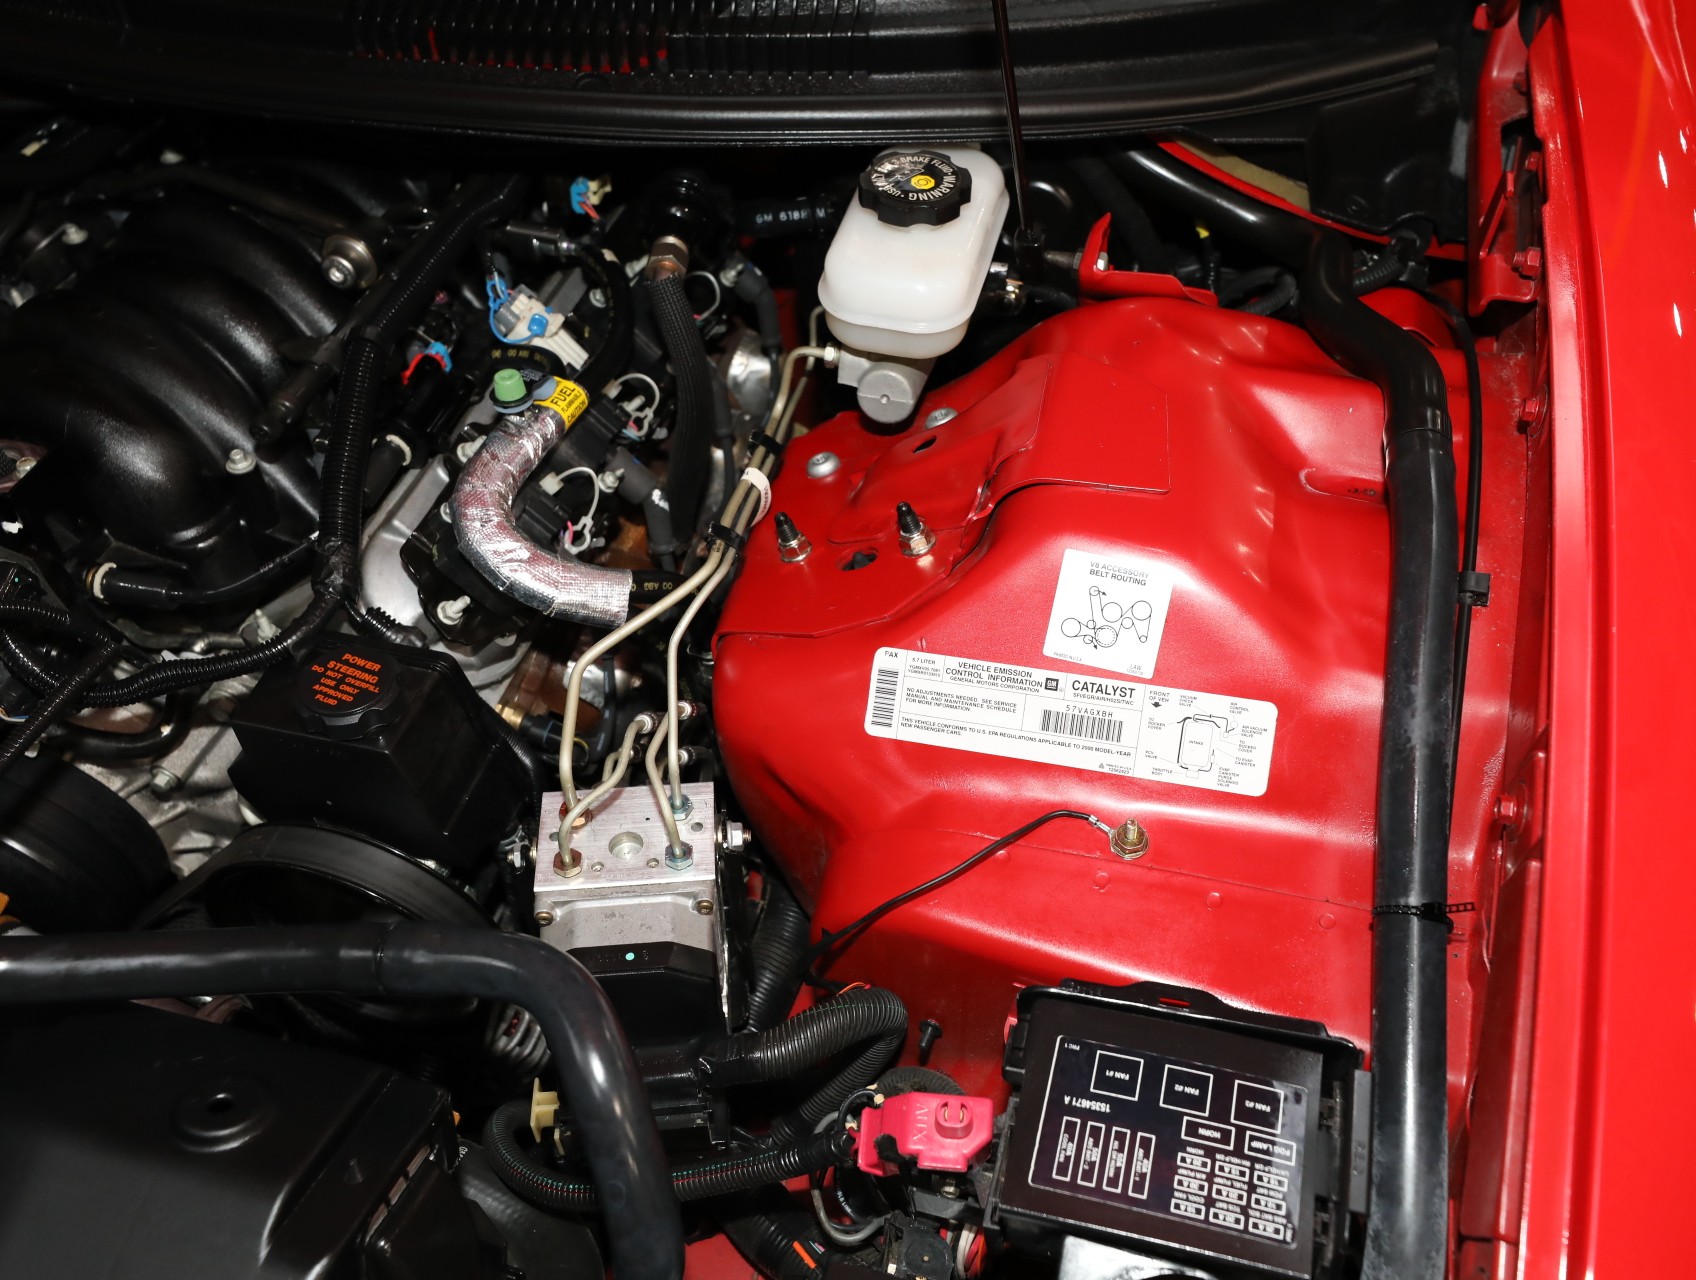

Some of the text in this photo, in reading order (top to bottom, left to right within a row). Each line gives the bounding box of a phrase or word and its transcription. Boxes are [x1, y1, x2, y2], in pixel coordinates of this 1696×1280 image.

[930, 160, 954, 176] FLUID
[908, 175, 956, 200] WARNING
[551, 386, 575, 407] FUEL
[567, 399, 586, 422] CAUTION
[1089, 568, 1146, 586] BELT ROUTING
[1101, 563, 1149, 578] ACCESSORY
[342, 653, 381, 671] POWER
[958, 661, 1032, 678] VEHICLE EMISSION
[327, 660, 378, 683] STEERING
[945, 667, 983, 679] CONTROL
[987, 673, 1043, 687] INFORMATION
[320, 677, 359, 694] USE ONLY
[326, 670, 342, 679] NOT
[345, 677, 379, 693] OVERFILL
[949, 675, 979, 684] GENERAL
[1000, 682, 1039, 693] CORPORATION
[1071, 679, 1135, 699] CATALYST
[313, 685, 353, 702] APPROVED
[315, 694, 337, 705] FLUID
[915, 688, 954, 699] ADJUSTMENTS
[955, 694, 978, 702] NEEDED.
[993, 700, 1016, 708] SERVICE
[933, 701, 972, 712] INFORMATION.
[944, 698, 983, 708] MAINTENANCE
[986, 704, 1016, 713] SCHEDULE
[1065, 704, 1113, 718] 57VAGXBH
[913, 724, 945, 733] PASSENGER
[936, 722, 967, 731] CONFORMS
[999, 732, 1037, 742] REGULATIONS
[1037, 738, 1071, 748] APPLICABLE
[1094, 746, 1131, 757] MODEL-YEAR
[1104, 1068, 1130, 1081] FAN #1
[1172, 1083, 1199, 1096] FAN #2
[1062, 1094, 1070, 1104] A
[1257, 1100, 1271, 1112] FAN
[912, 1104, 930, 1141] AUX
[1196, 1126, 1221, 1139] HORN
[1249, 1139, 1290, 1156] FOG LAMP
